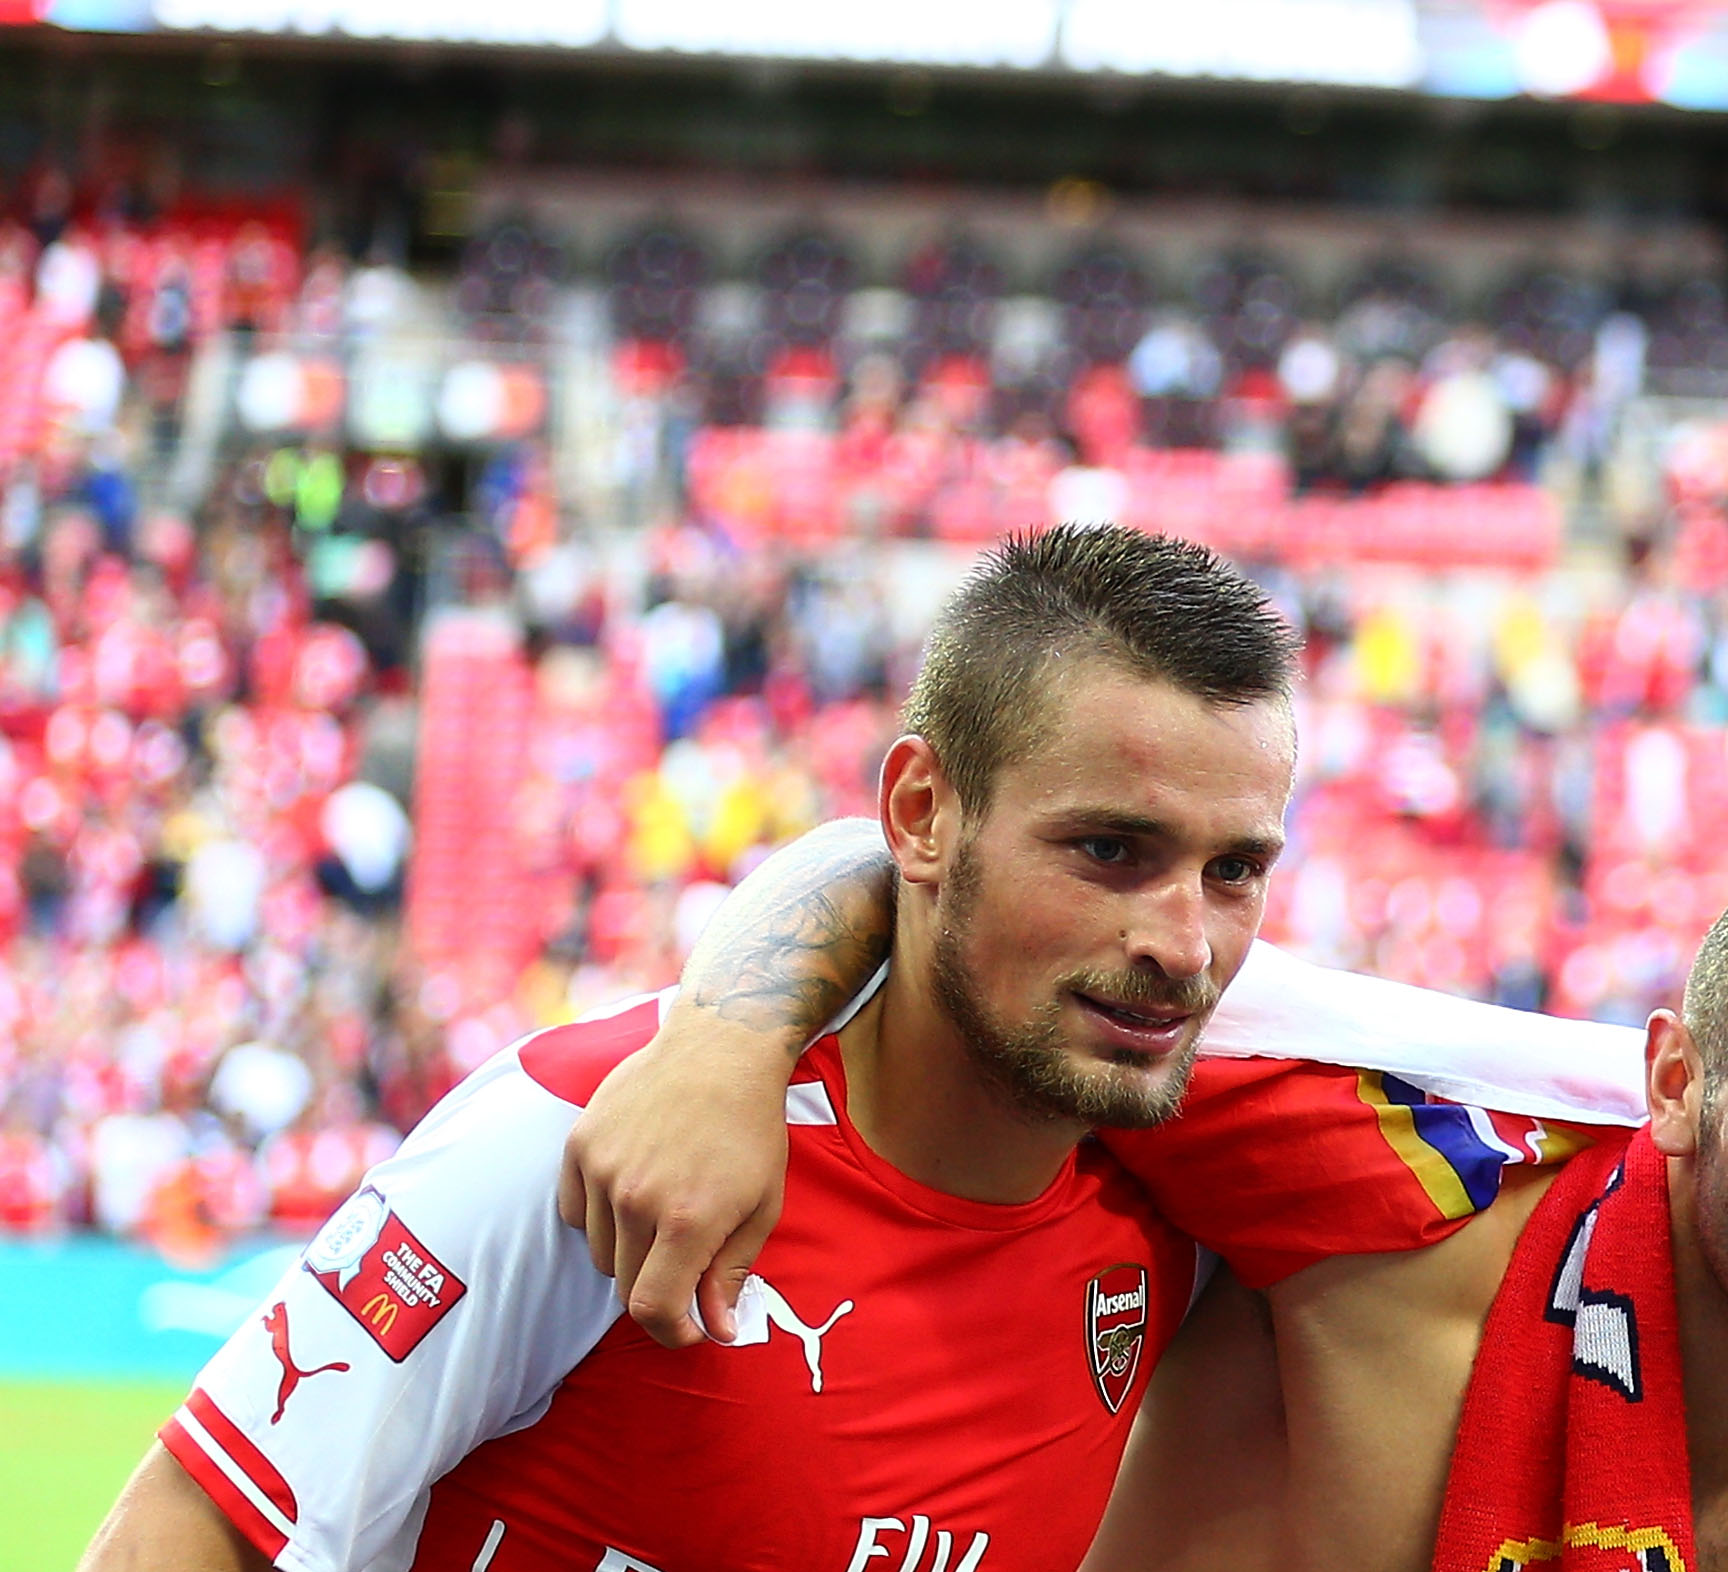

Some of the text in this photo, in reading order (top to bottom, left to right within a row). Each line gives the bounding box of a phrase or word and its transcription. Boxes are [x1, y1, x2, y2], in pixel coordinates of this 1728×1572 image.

[382, 1250, 442, 1308] COMMUNITY
[384, 1270, 419, 1307] SHIELD
[397, 1242, 446, 1294] THE FA
[1096, 1285, 1144, 1317] Arsenal
